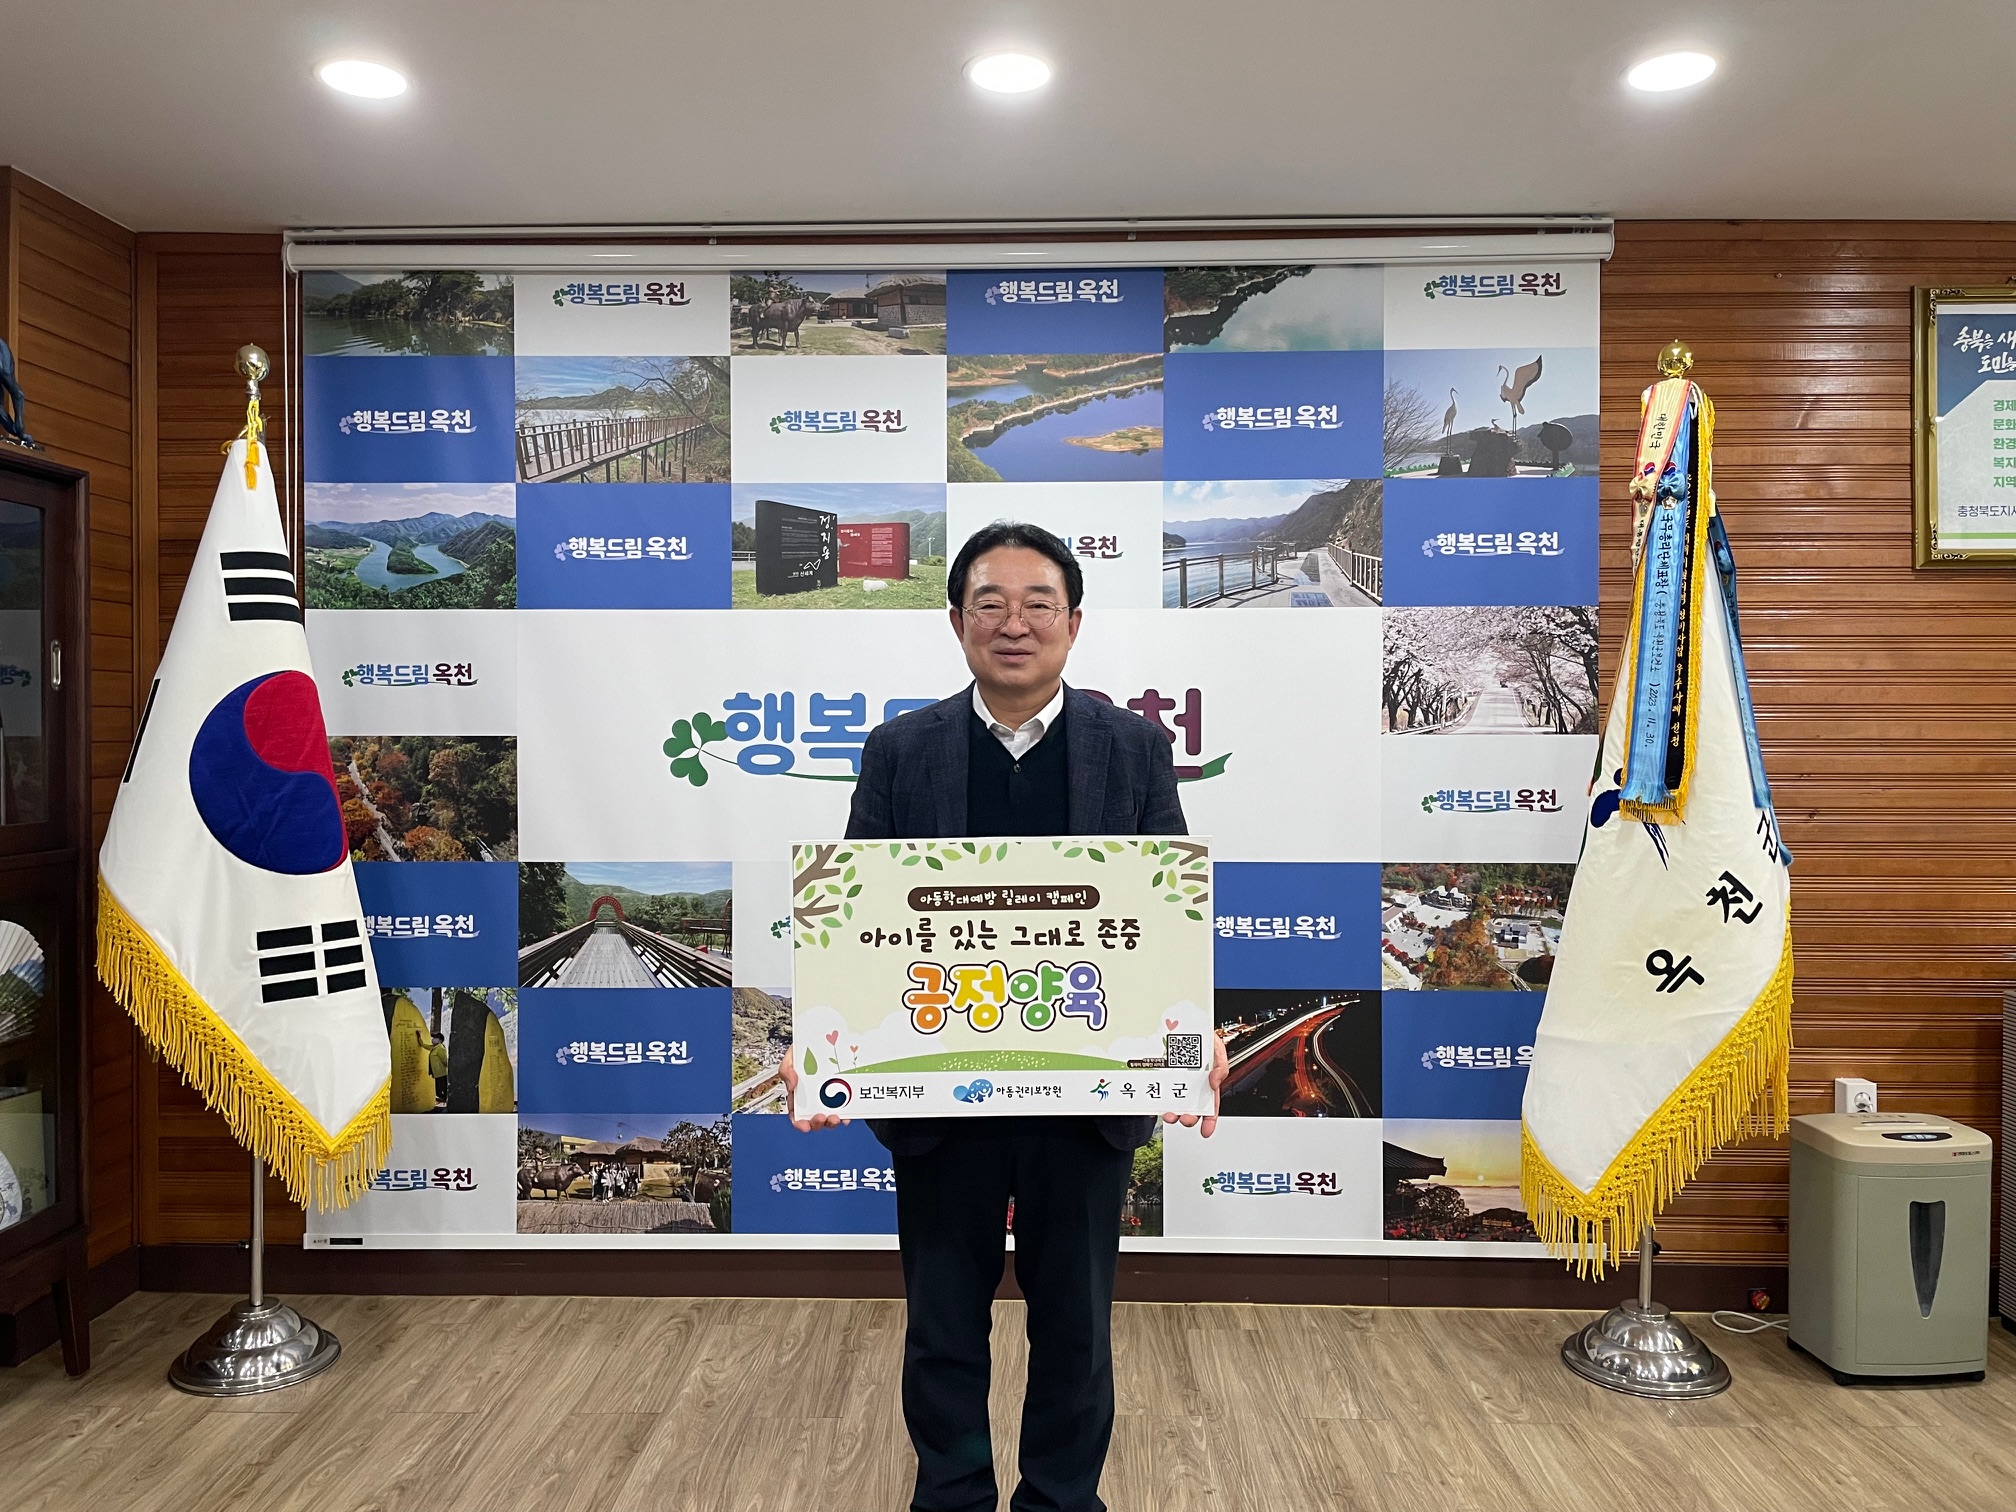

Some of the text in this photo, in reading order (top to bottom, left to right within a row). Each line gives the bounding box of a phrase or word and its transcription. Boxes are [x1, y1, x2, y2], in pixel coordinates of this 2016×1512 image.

[567, 282, 685, 305] 행복드림 옥천
[999, 278, 1119, 303] 행복드림 옥천
[1439, 272, 1562, 296] 행복드림 옥천
[1953, 326, 1994, 353] 충북을
[353, 408, 471, 432] 행복드림 옥천
[783, 409, 902, 432] 행복드림 옥천
[1216, 405, 1337, 430] 행복드림 옥천
[1650, 413, 1668, 450] 대한민국
[1993, 457, 2016, 469] 복지
[1993, 476, 2016, 488] 지역
[567, 536, 687, 560] 행복드림 옥천
[1076, 536, 1117, 559] 옥천
[1436, 531, 1559, 557] 행복드림 옥천
[357, 662, 474, 687] 행복드림 옥천
[722, 692, 930, 776] 행복
[1094, 687, 1203, 779] 천
[1436, 788, 1558, 813] 행복드림 옥천
[919, 888, 1087, 907] 아동학대예방 릴레이 캠페인
[433, 914, 474, 938] 옥천
[859, 917, 1141, 953] 아이를 있는 그대로 존중
[1215, 915, 1336, 940] 행복드림 옥천
[902, 960, 1107, 1034] 긍정양육
[570, 1040, 688, 1065] 행복드림 옥천
[1436, 1045, 1534, 1068] 행복드림 옥
[859, 1085, 925, 1101] 보건복지부
[996, 1085, 1062, 1099] 아동권리보장원
[1119, 1081, 1188, 1099] 옥천군
[431, 1167, 472, 1191] 옥천
[784, 1168, 857, 1191] 행복드림
[1217, 1171, 1338, 1195] 행복드림 옥천
